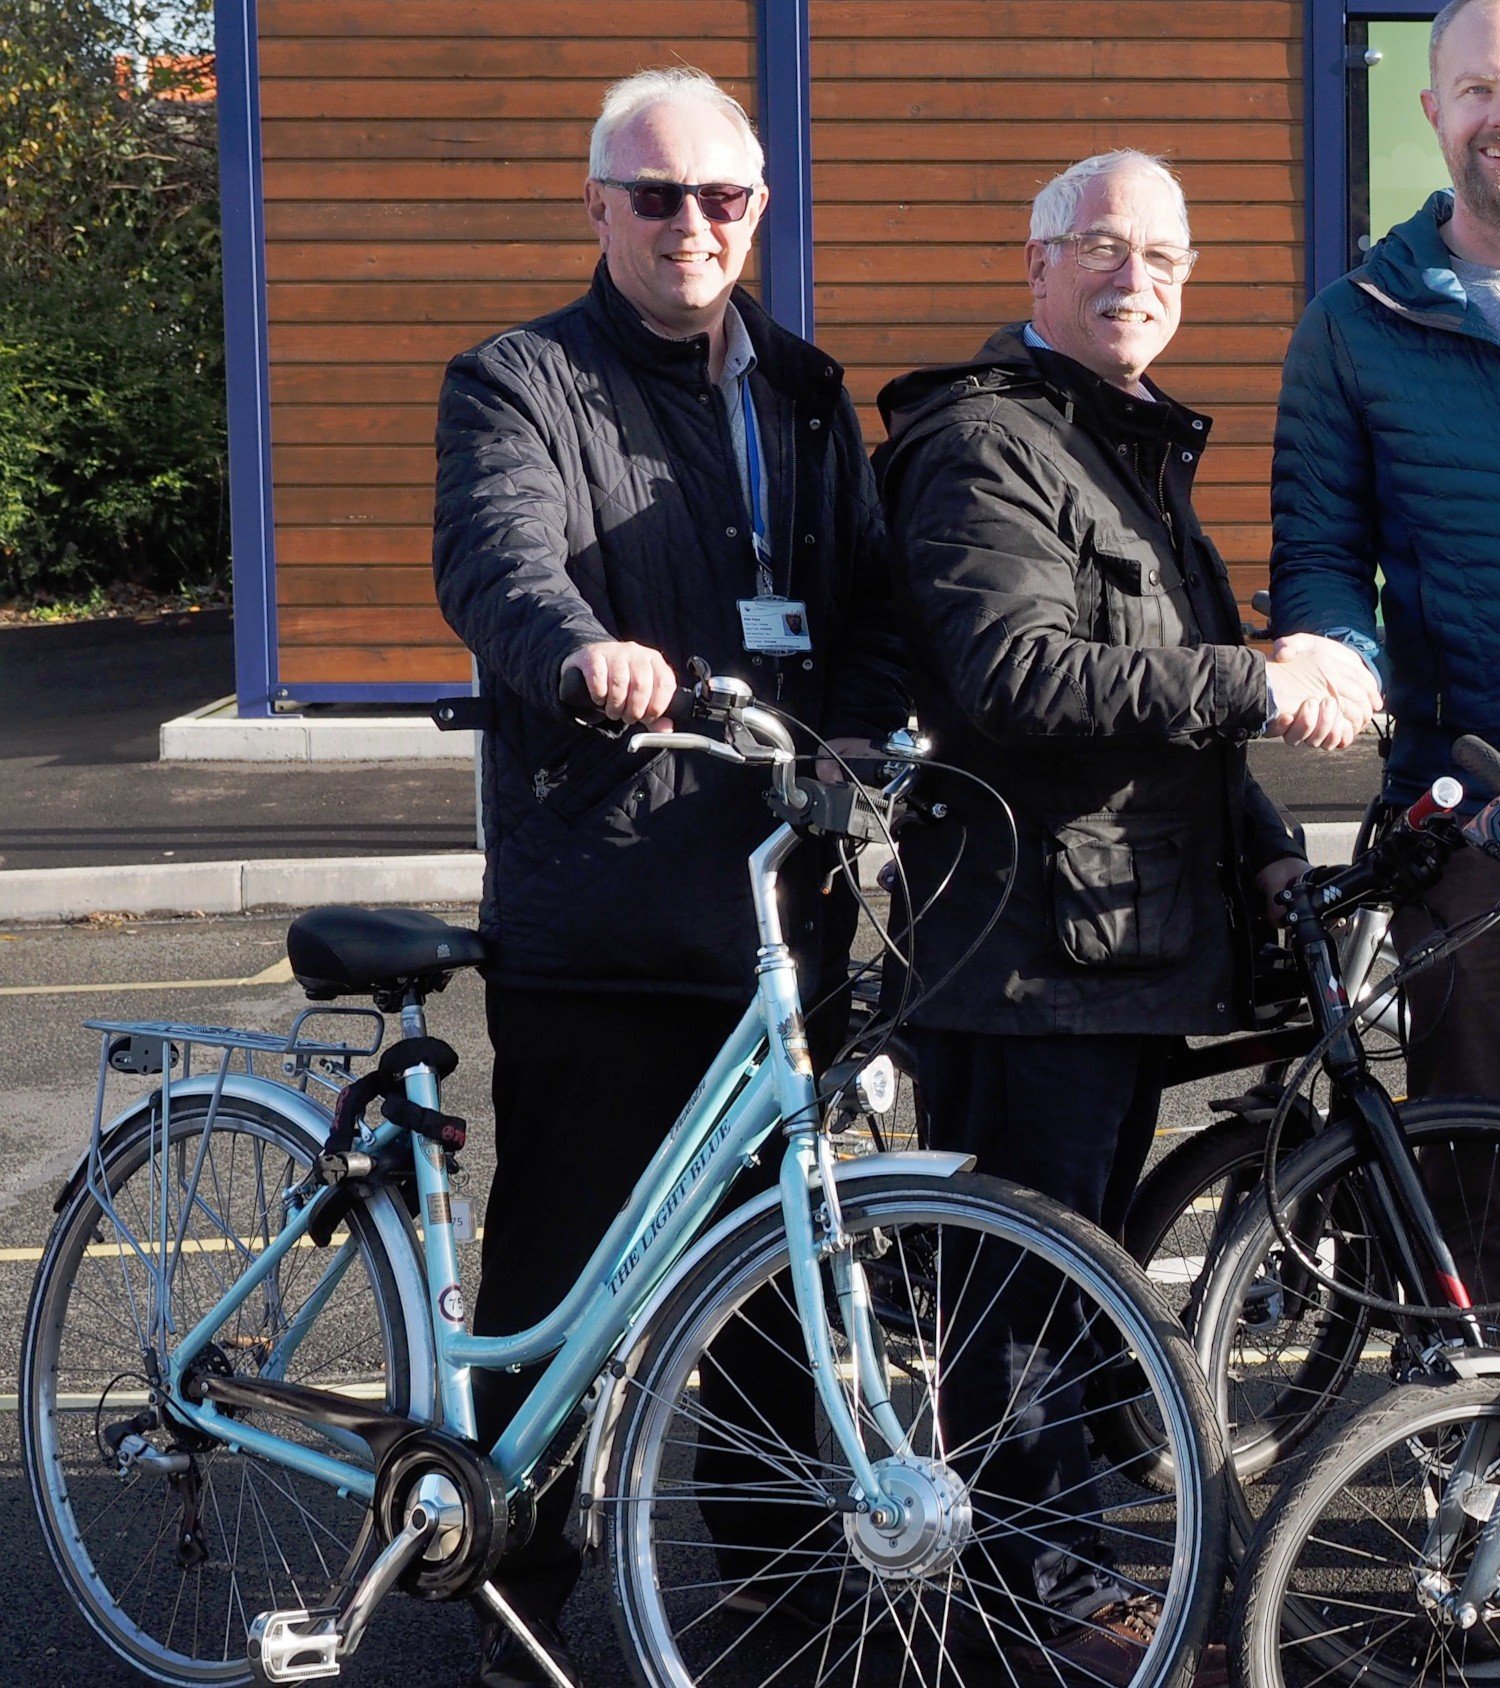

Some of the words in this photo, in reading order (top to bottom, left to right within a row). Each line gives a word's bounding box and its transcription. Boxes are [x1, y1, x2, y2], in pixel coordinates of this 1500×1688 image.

[607, 1249, 640, 1298] THE
[641, 1176, 688, 1246] LIGHT
[690, 1118, 731, 1181] BLUE
